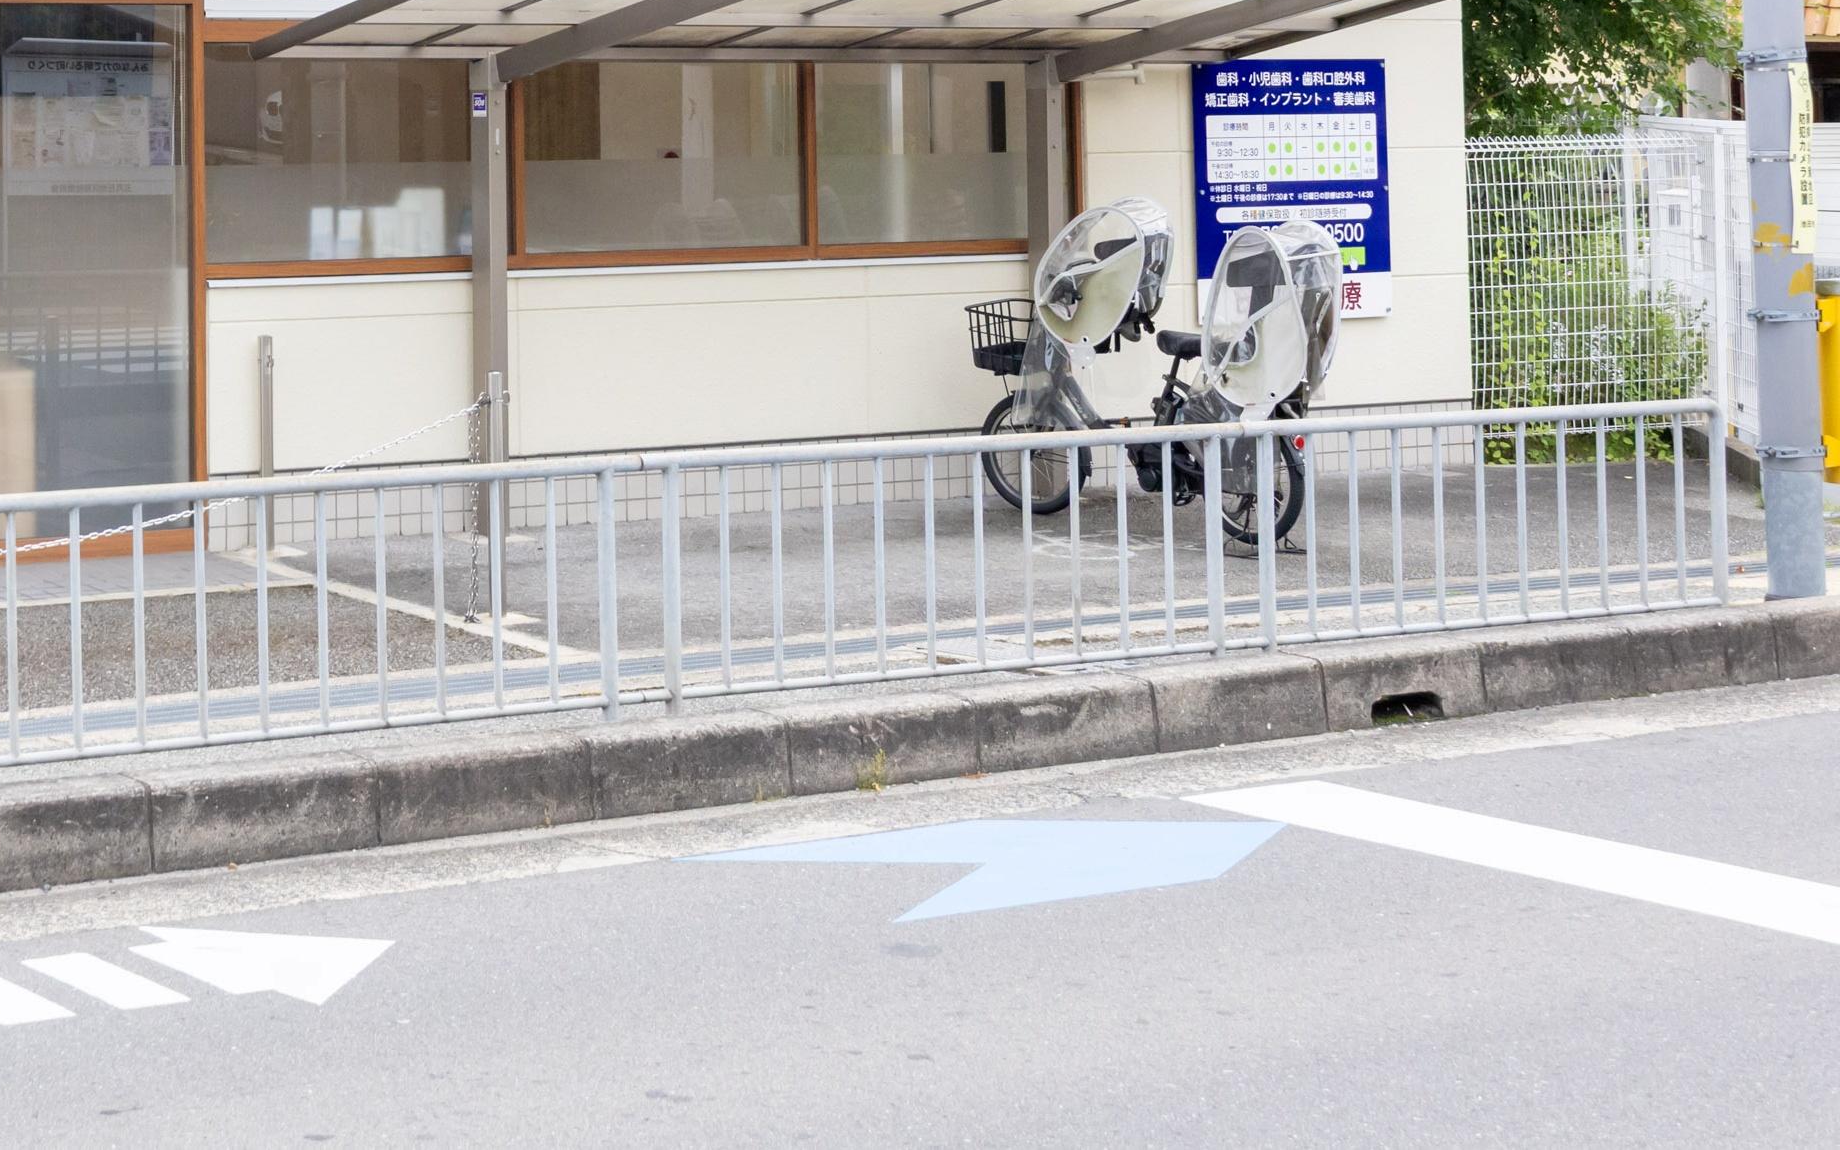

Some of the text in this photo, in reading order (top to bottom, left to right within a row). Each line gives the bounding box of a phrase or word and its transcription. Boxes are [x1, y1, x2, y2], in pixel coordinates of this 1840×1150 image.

[1216, 71, 1365, 87] 歯科・小児歯科・歯科口腔外科
[1268, 121, 1275, 131] 月
[1365, 120, 1371, 130] 日
